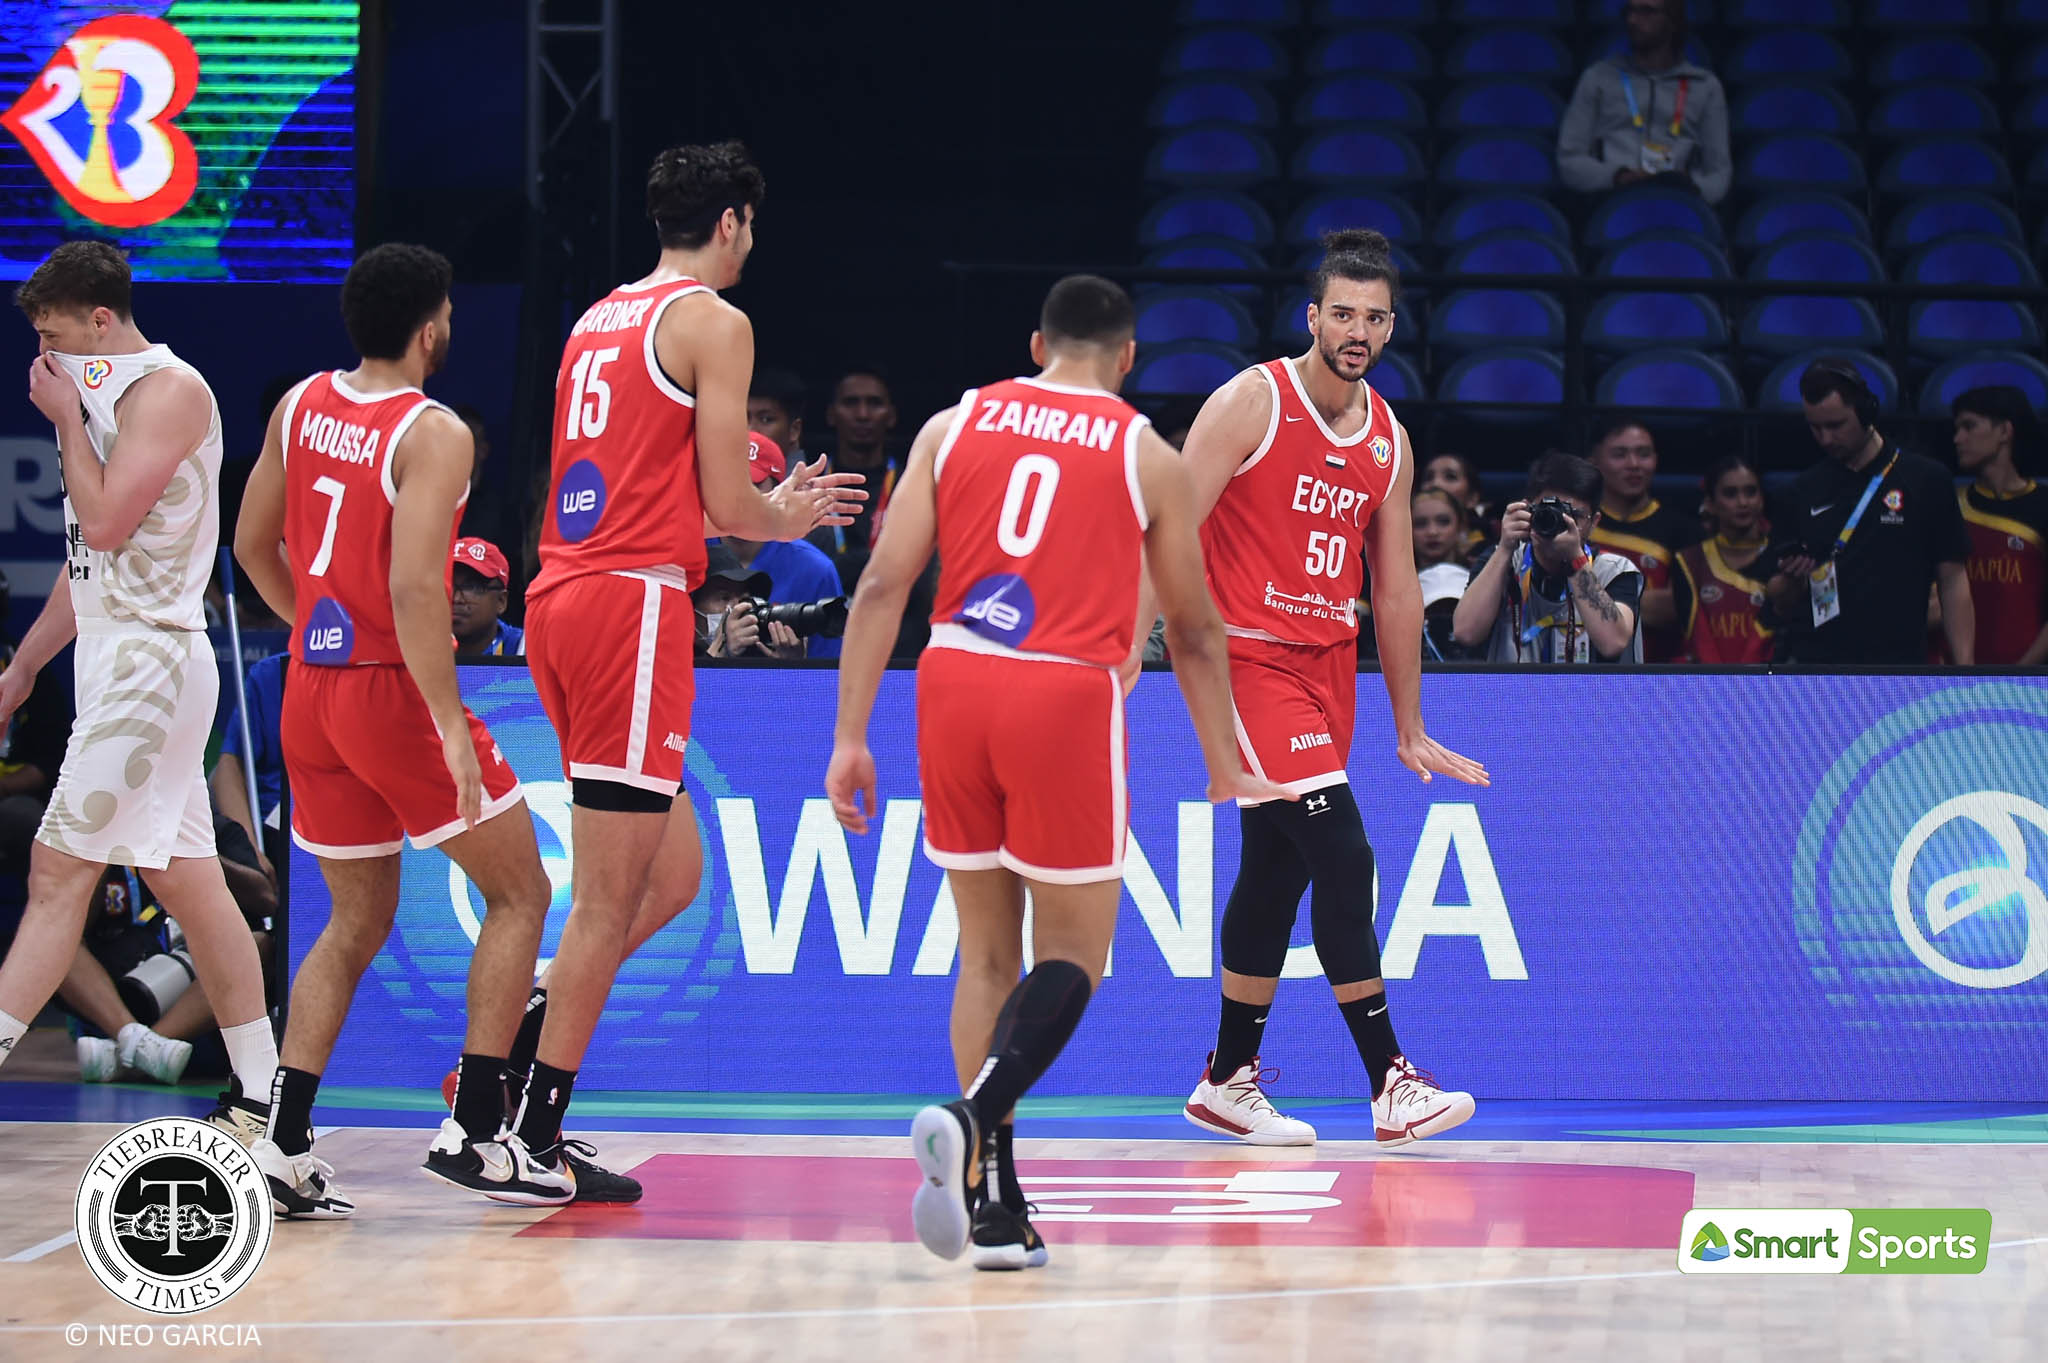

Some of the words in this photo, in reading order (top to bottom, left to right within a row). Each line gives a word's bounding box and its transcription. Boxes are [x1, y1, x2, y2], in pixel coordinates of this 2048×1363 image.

[566, 347, 621, 441] 15
[299, 408, 380, 468] MOUSSA
[975, 399, 1118, 452] ZAHRAN
[308, 475, 346, 577] 7
[563, 489, 597, 514] we
[997, 453, 1060, 558] 0
[1292, 474, 1369, 527] EGYPT
[1305, 530, 1347, 579] 50
[1264, 595, 1309, 616] Banque
[1312, 605, 1328, 619] du
[309, 627, 344, 651] we
